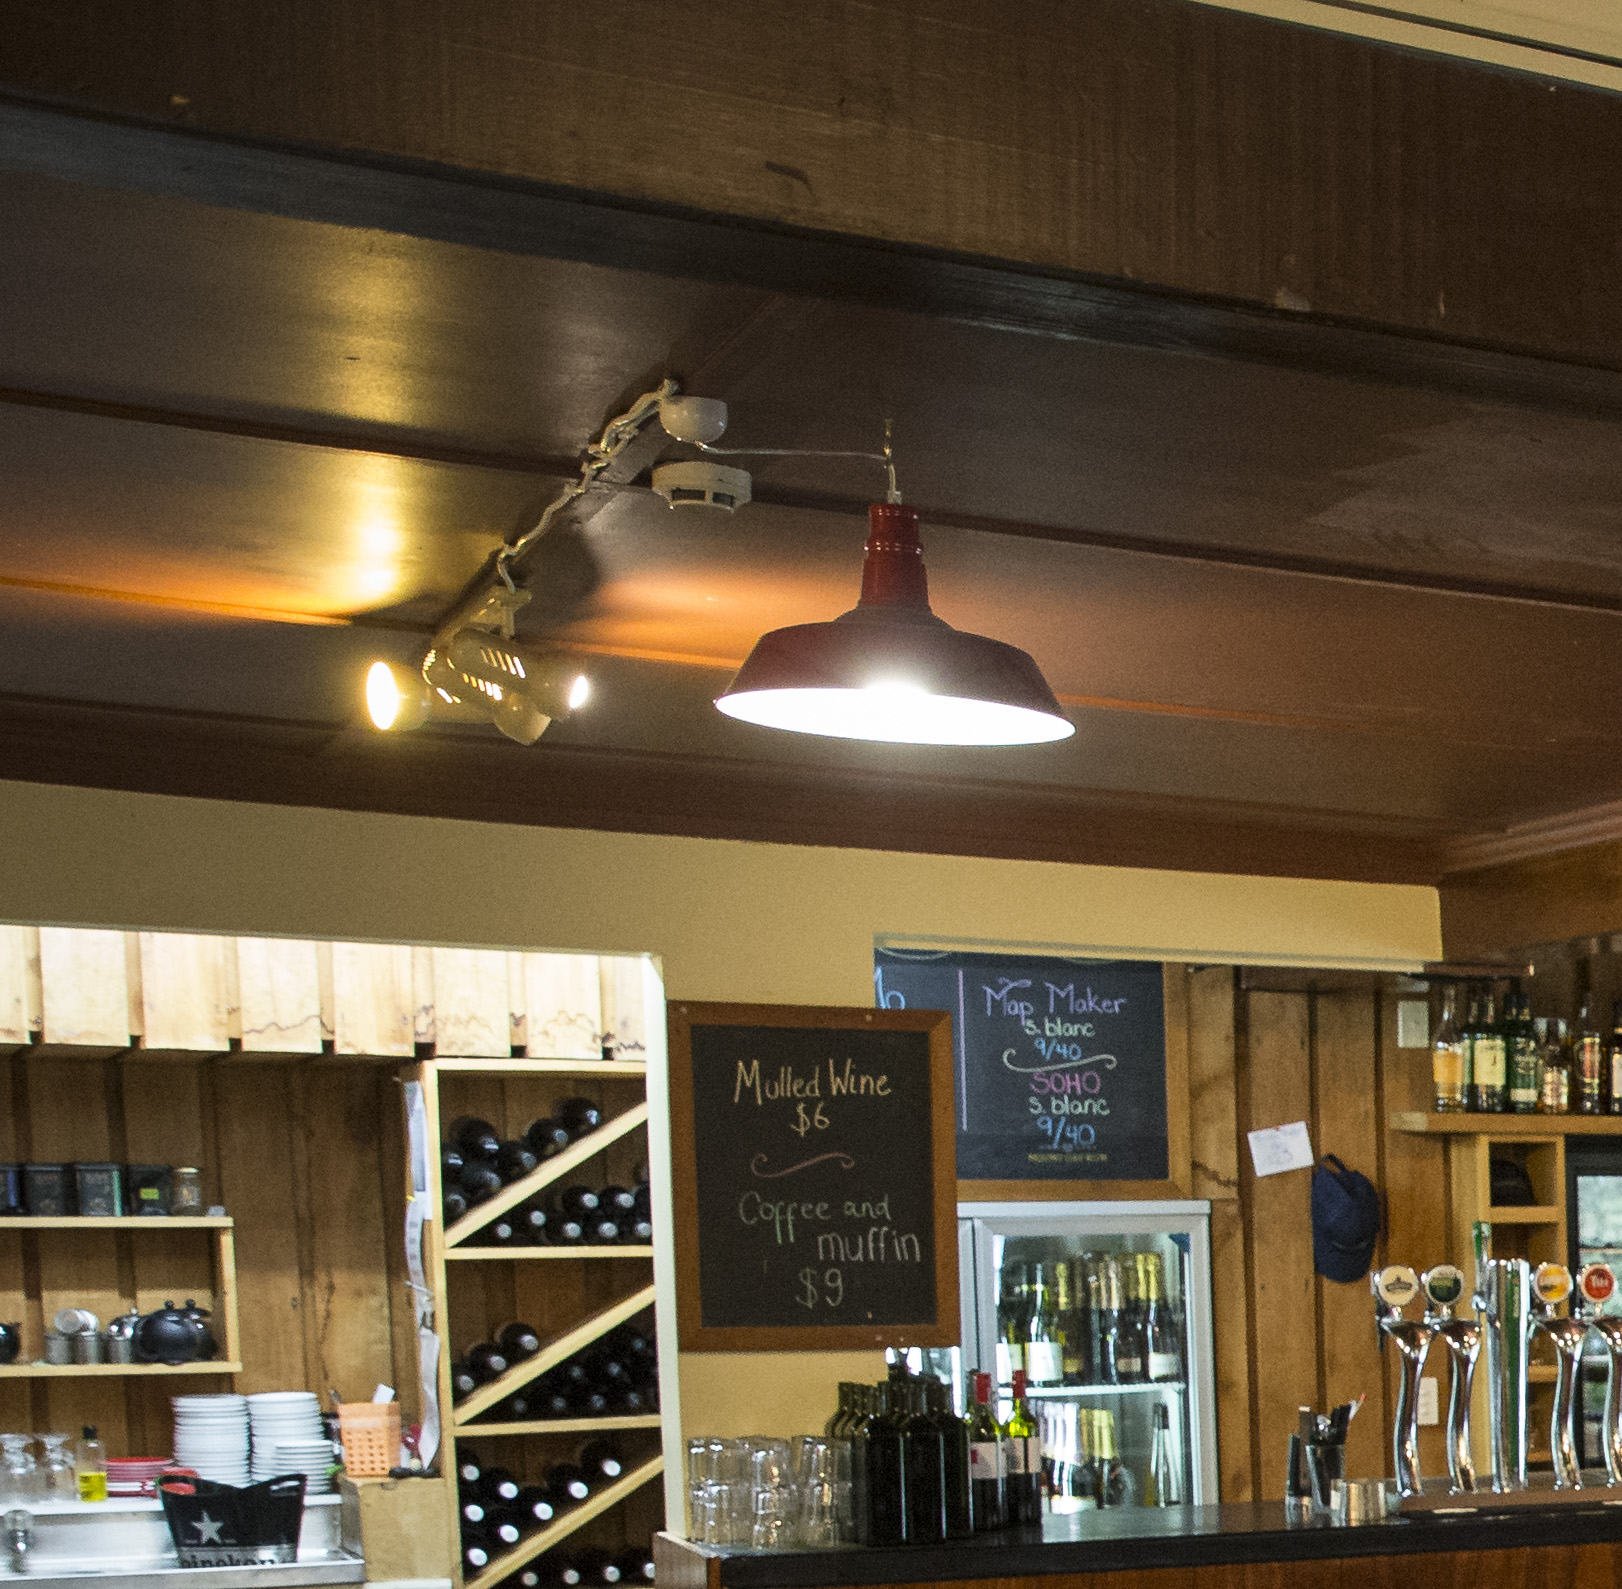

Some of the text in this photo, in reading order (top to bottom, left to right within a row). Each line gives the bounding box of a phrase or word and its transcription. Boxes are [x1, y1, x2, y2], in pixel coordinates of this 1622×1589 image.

[982, 977, 1127, 1026] Map Maker
[1044, 1015, 1096, 1037] blanc
[1034, 1037, 1082, 1061] 9/40
[734, 1058, 892, 1105] Mulled Wine
[1029, 1070, 1101, 1095] SOHO
[790, 1101, 830, 1137] $6
[1050, 1094, 1111, 1116] blanc
[1036, 1116, 1096, 1149] 9/40
[739, 1191, 892, 1245] Coffee and
[817, 1226, 921, 1263] muffin
[795, 1267, 844, 1308] $9
